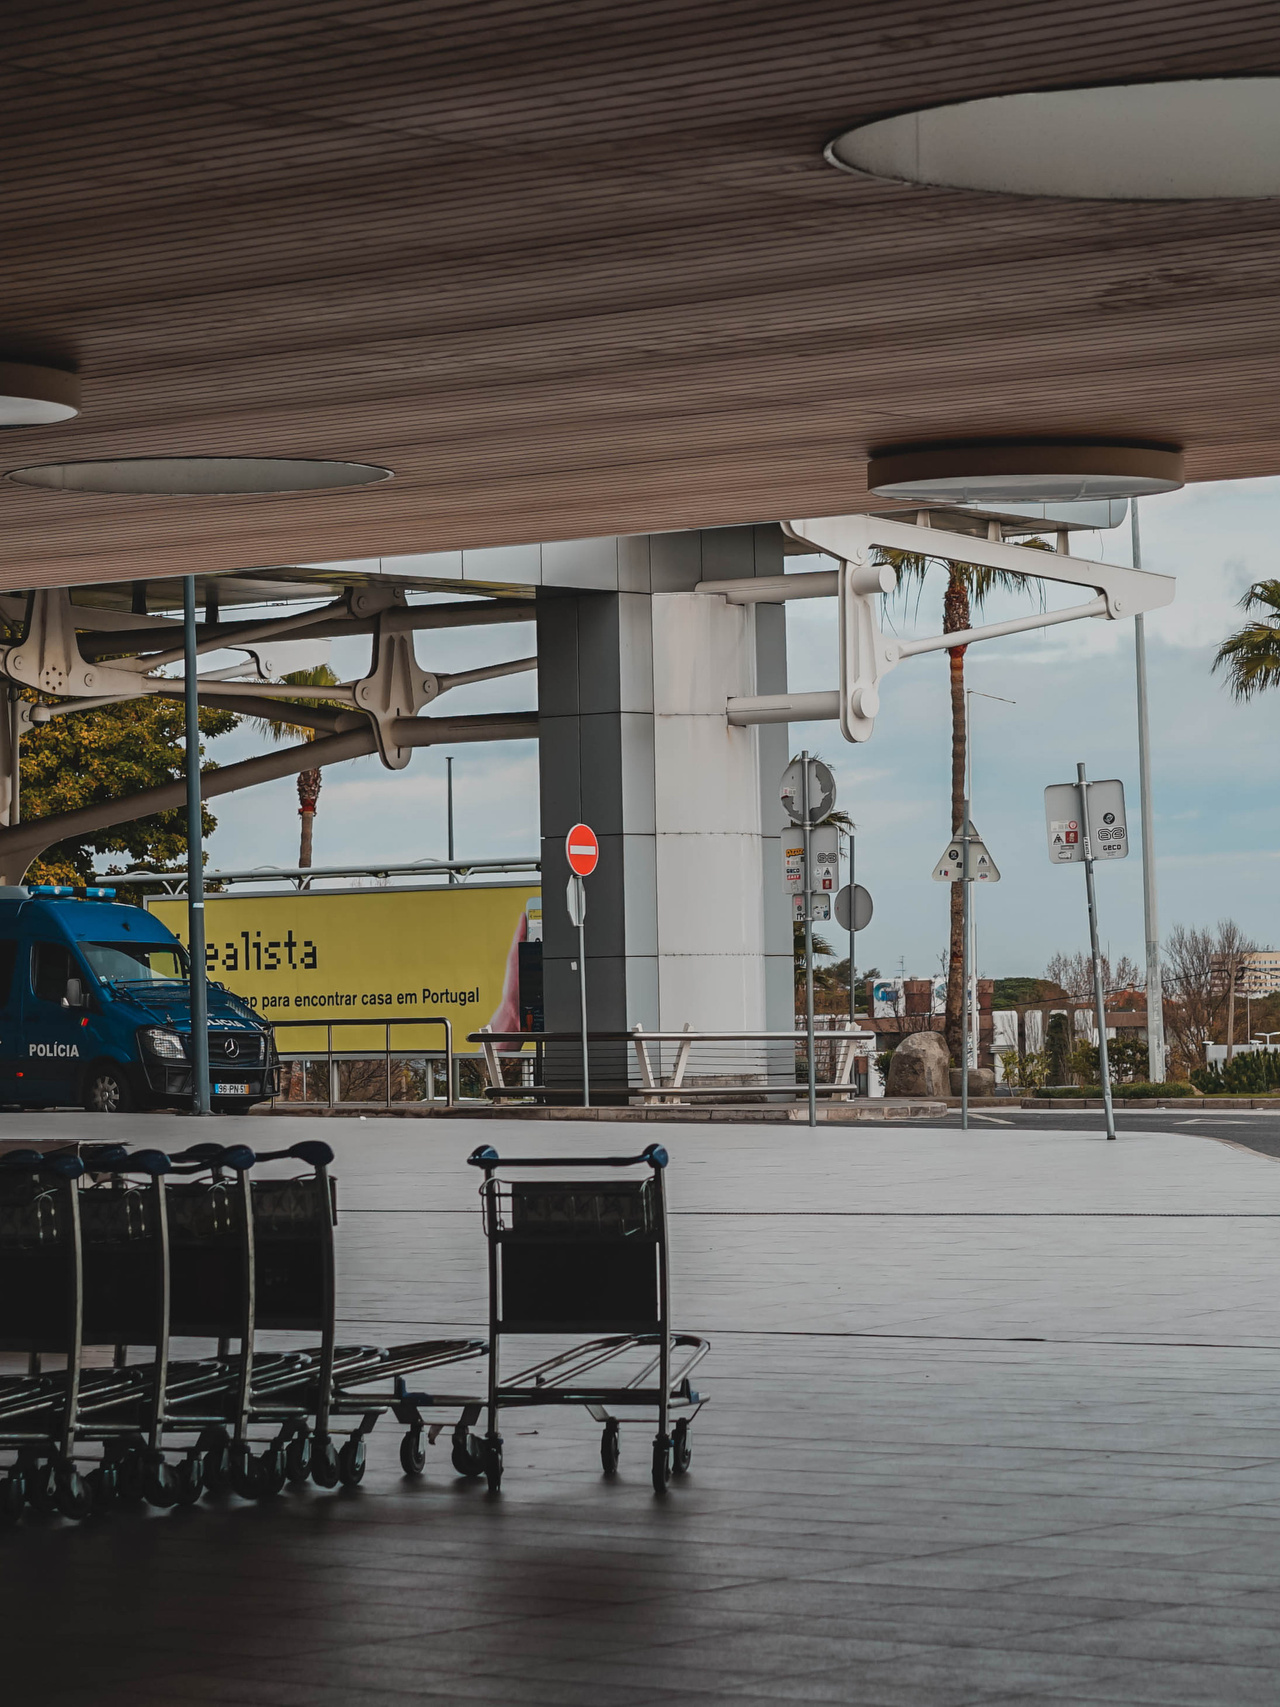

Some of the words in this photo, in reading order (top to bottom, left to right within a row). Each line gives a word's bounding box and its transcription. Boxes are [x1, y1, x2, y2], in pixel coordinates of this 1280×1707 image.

[177, 930, 317, 971] ealista
[262, 995, 290, 1010] para
[294, 991, 358, 1007] encontrar
[361, 993, 392, 1006] casa
[397, 992, 417, 1004] em
[422, 987, 479, 1006] Portugal
[29, 1041, 79, 1057] POLÍCIA
